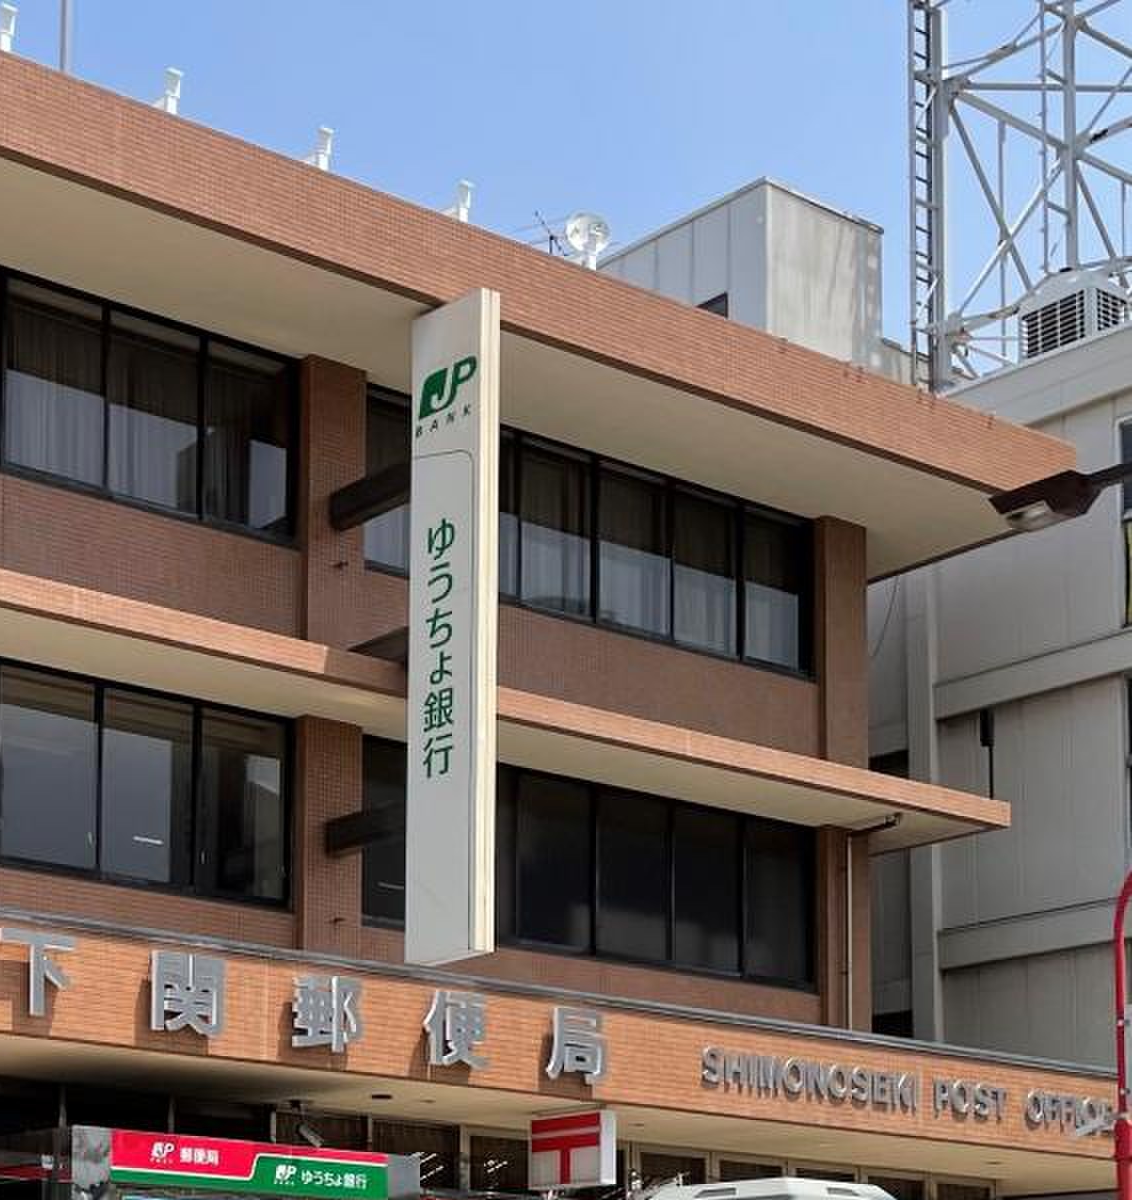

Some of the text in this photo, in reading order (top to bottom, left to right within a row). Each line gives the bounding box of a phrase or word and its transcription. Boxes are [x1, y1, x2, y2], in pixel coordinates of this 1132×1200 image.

[415, 403, 471, 438] BANK
[422, 518, 456, 779] ゆうちょ銀行
[701, 1045, 917, 1116] SHIMONOSEKI
[933, 1078, 1007, 1122] POST
[180, 1146, 220, 1167] 郵便局
[301, 1169, 368, 1190] ゆうちょ銀行
